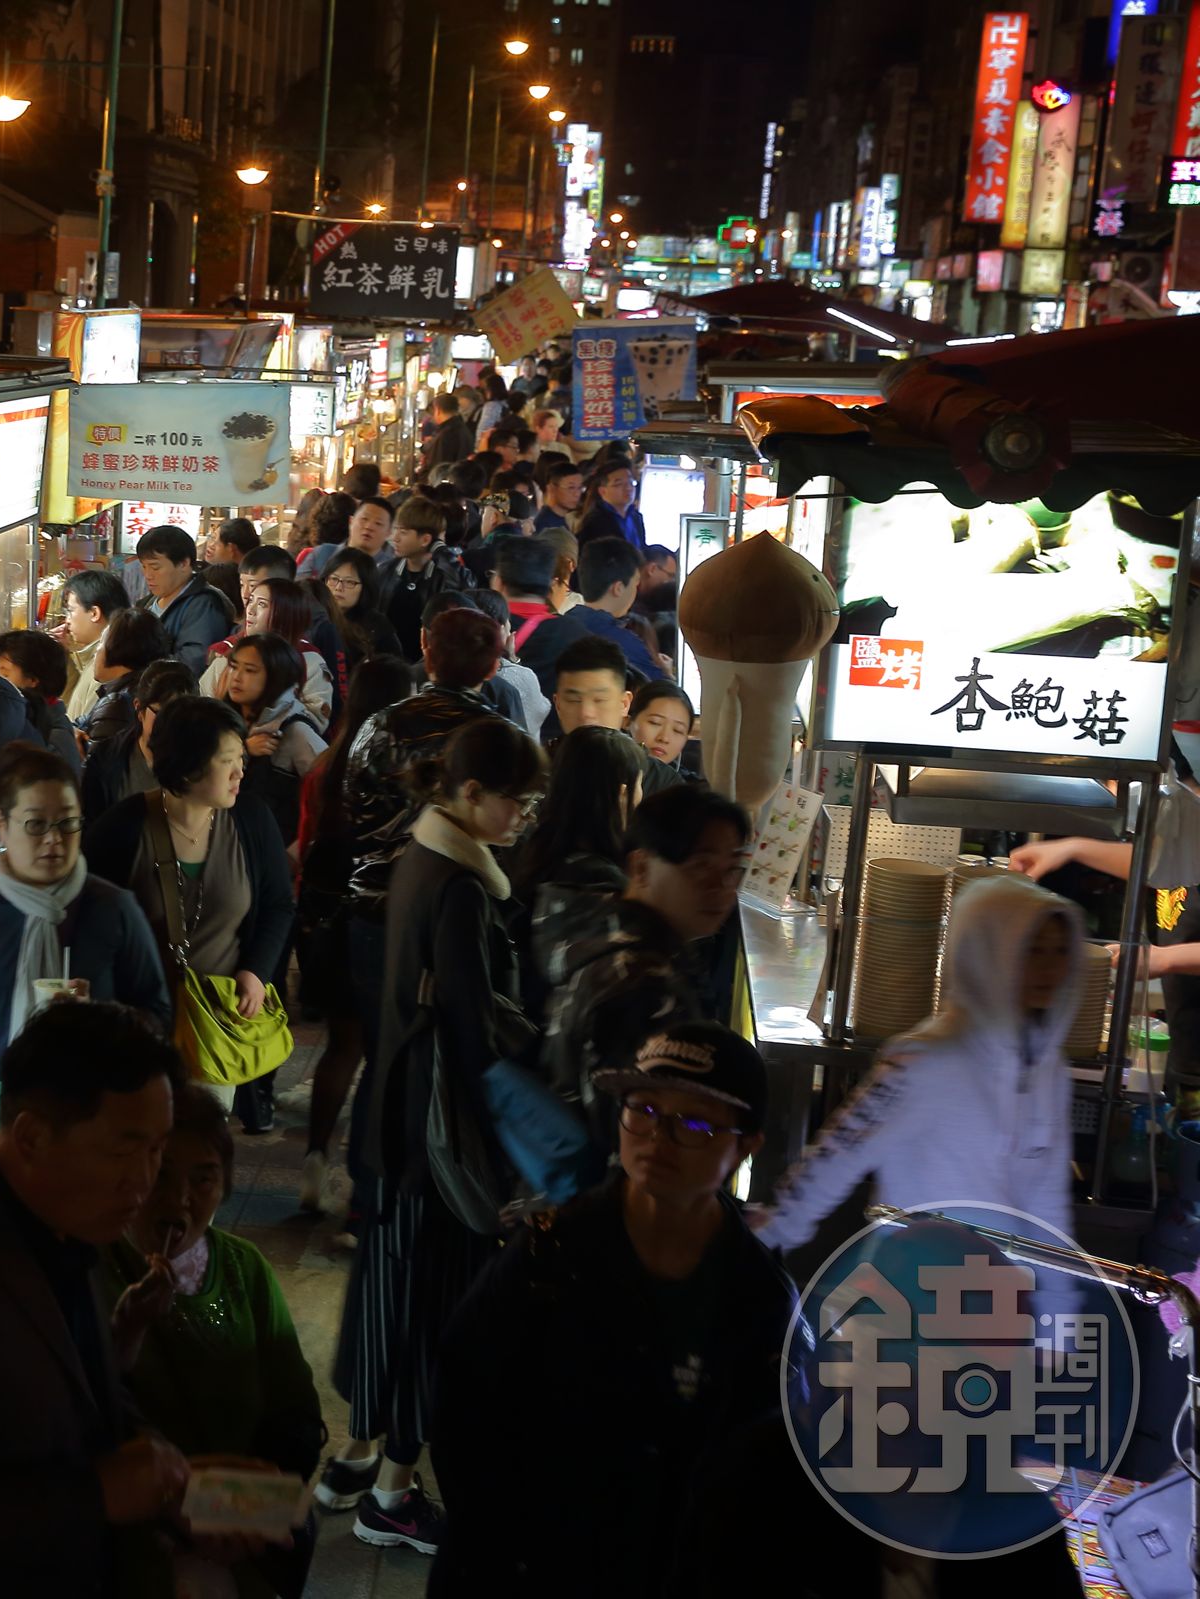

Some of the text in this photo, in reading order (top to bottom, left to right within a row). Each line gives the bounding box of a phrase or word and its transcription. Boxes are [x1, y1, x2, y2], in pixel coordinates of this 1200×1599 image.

[314, 224, 346, 255] HOT
[394, 237, 449, 255] 古早味
[321, 261, 449, 299] 紅茶鮮乳
[94, 426, 122, 441] 特價
[82, 453, 220, 473] 蜂蜜珍珠鮮奶茶
[81, 478, 193, 491] Honey Pear Milk Tea
[852, 638, 923, 689] 鹽烤
[930, 656, 1130, 747] 杏鮑菇
